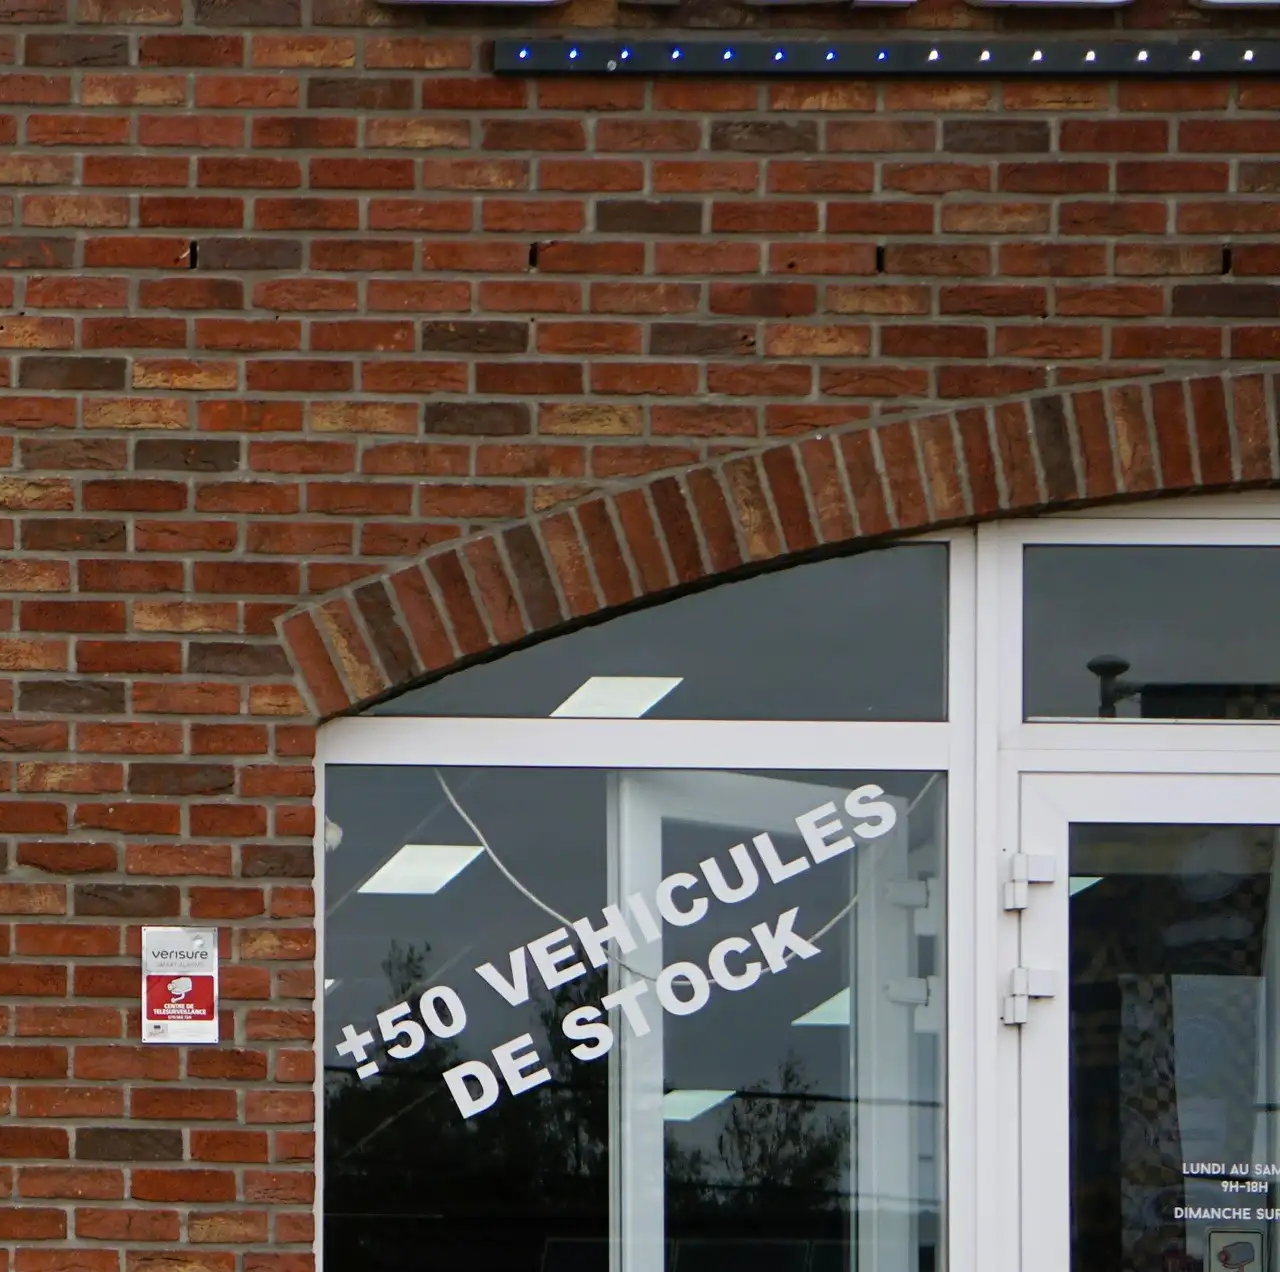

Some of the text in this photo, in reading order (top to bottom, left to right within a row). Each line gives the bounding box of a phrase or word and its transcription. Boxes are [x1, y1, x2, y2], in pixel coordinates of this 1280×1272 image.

[475, 783, 898, 1007] VEHICULES
[151, 949, 209, 960] verisure
[442, 906, 822, 1120] DE STOCK
[1182, 1162, 1226, 1175] LUNDI
[1230, 1163, 1249, 1175] AU
[1221, 1180, 1268, 1193] 9H-18H
[1173, 1206, 1252, 1219] DIMANCHE
